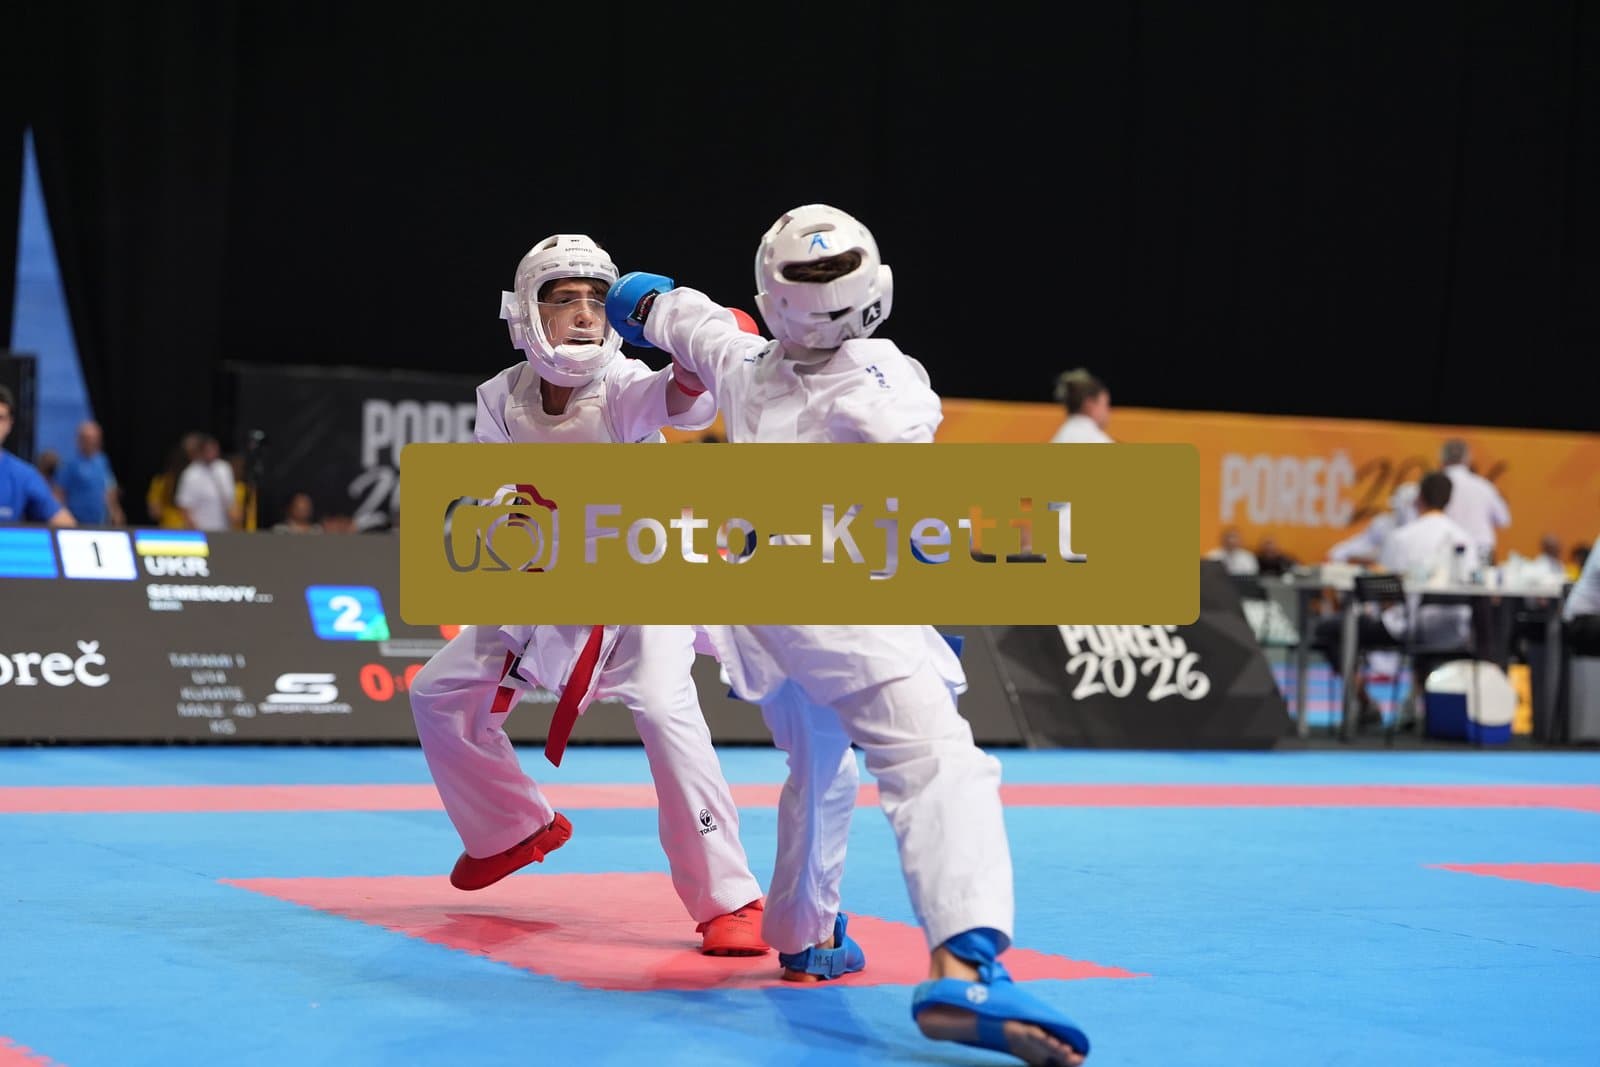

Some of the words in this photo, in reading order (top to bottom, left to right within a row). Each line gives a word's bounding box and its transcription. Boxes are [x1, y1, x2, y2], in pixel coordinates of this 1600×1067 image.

[1219, 449, 1355, 528] POREČ
[143, 555, 210, 578] UKR
[328, 595, 367, 633] 2
[1065, 651, 1211, 701] 2026
